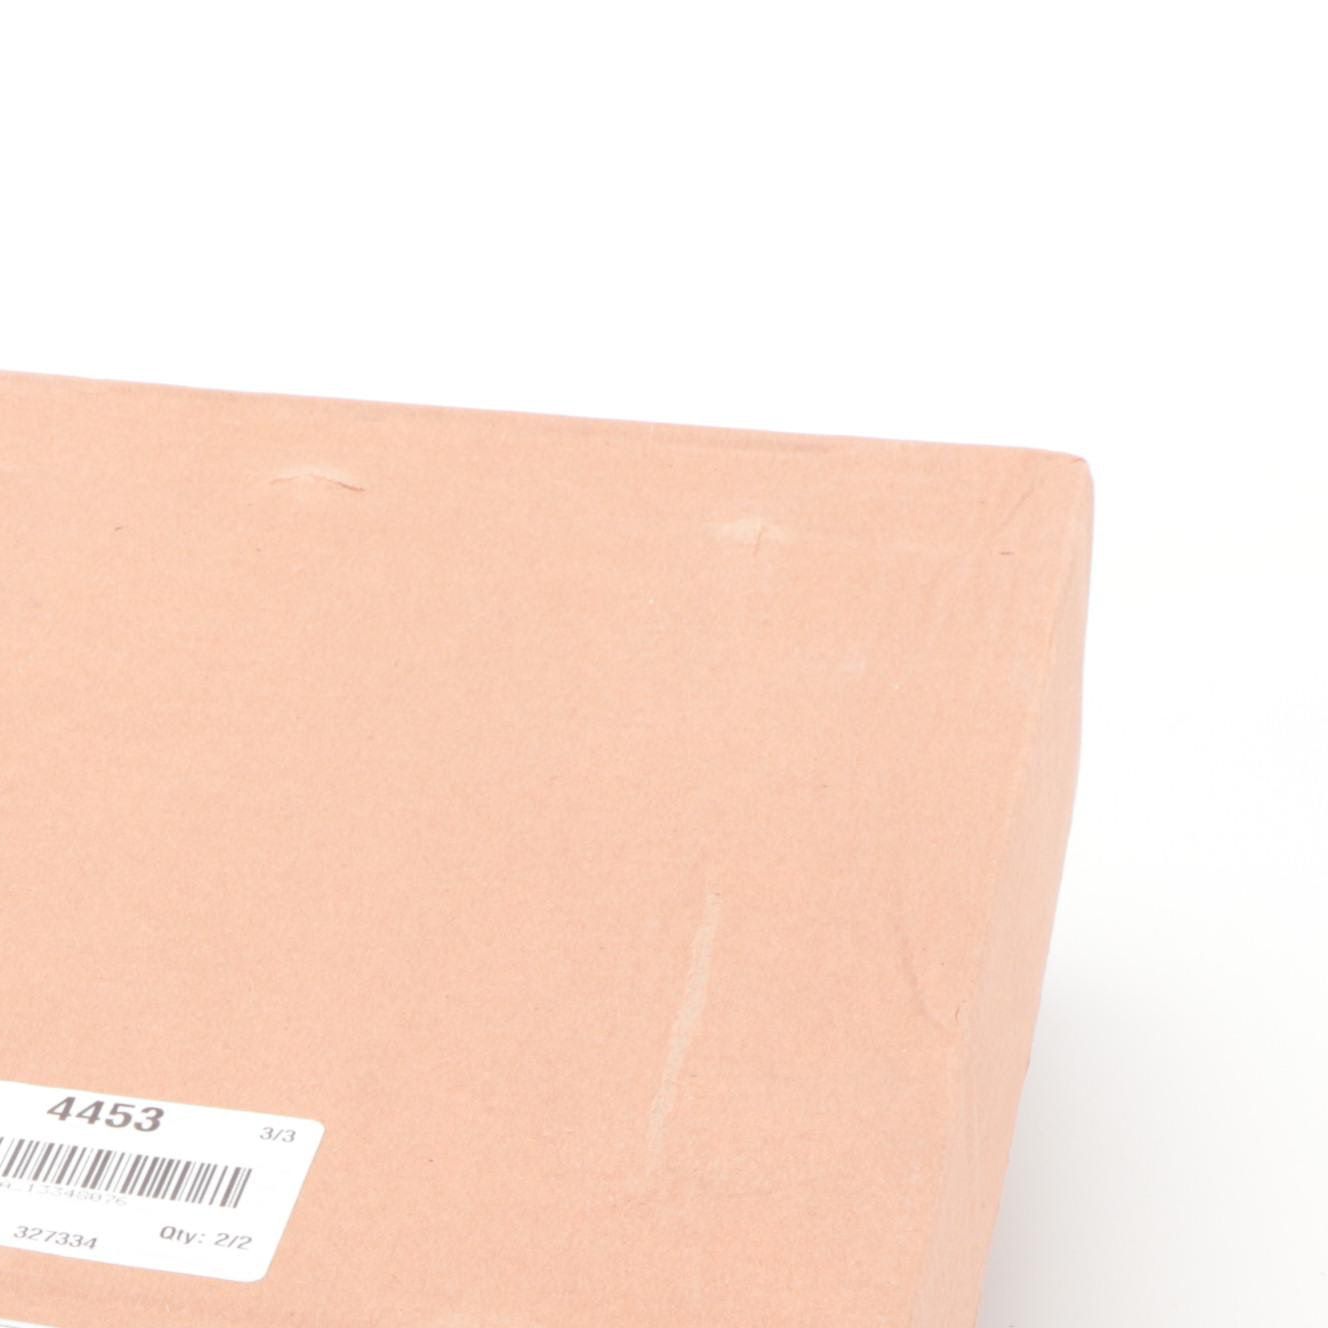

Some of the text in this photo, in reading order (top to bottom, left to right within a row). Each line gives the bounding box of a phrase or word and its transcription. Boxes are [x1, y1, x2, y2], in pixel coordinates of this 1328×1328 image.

[46, 1096, 166, 1133] 4453
[259, 1126, 297, 1144] 3/3
[13, 1225, 253, 1252] 327334 Qty: 2/2
